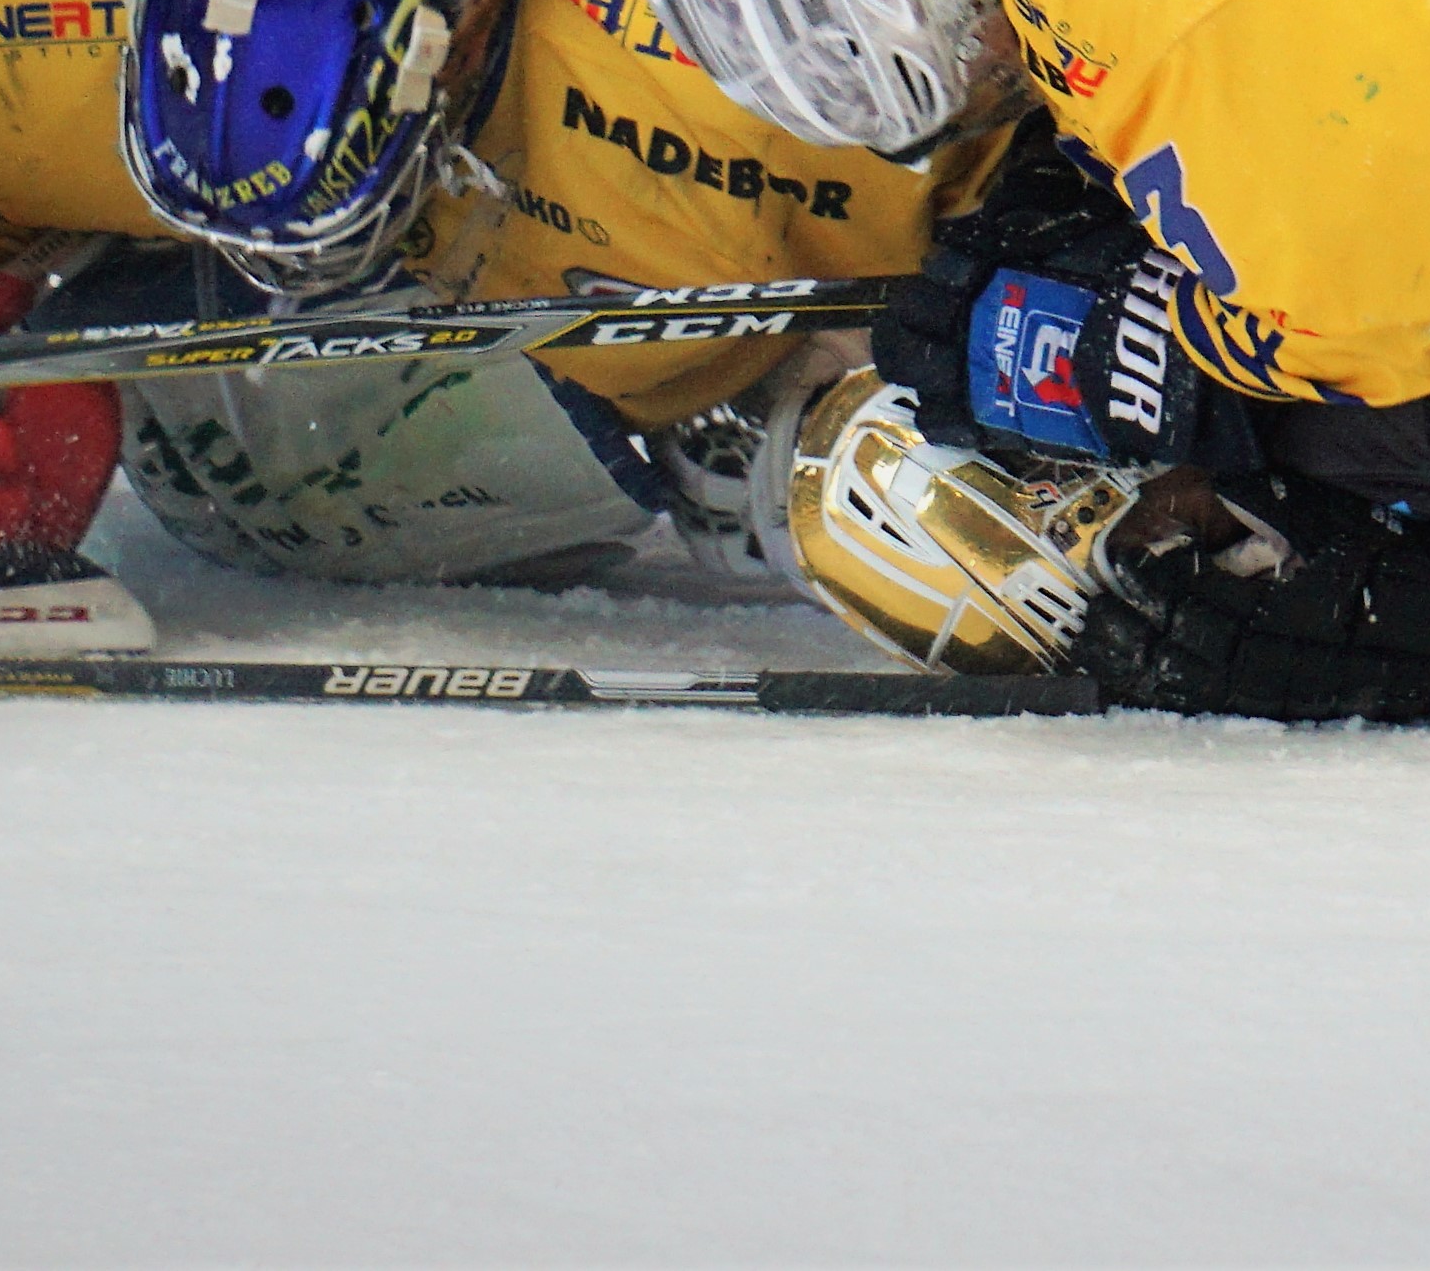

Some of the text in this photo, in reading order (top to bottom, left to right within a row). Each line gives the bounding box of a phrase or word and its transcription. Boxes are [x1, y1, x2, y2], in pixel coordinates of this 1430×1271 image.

[512, 180, 573, 236] AHO
[634, 277, 818, 309] CCM
[589, 310, 795, 346] CCM
[145, 327, 481, 370] SUPER TACKS 2.0
[323, 666, 535, 700] BAUER
